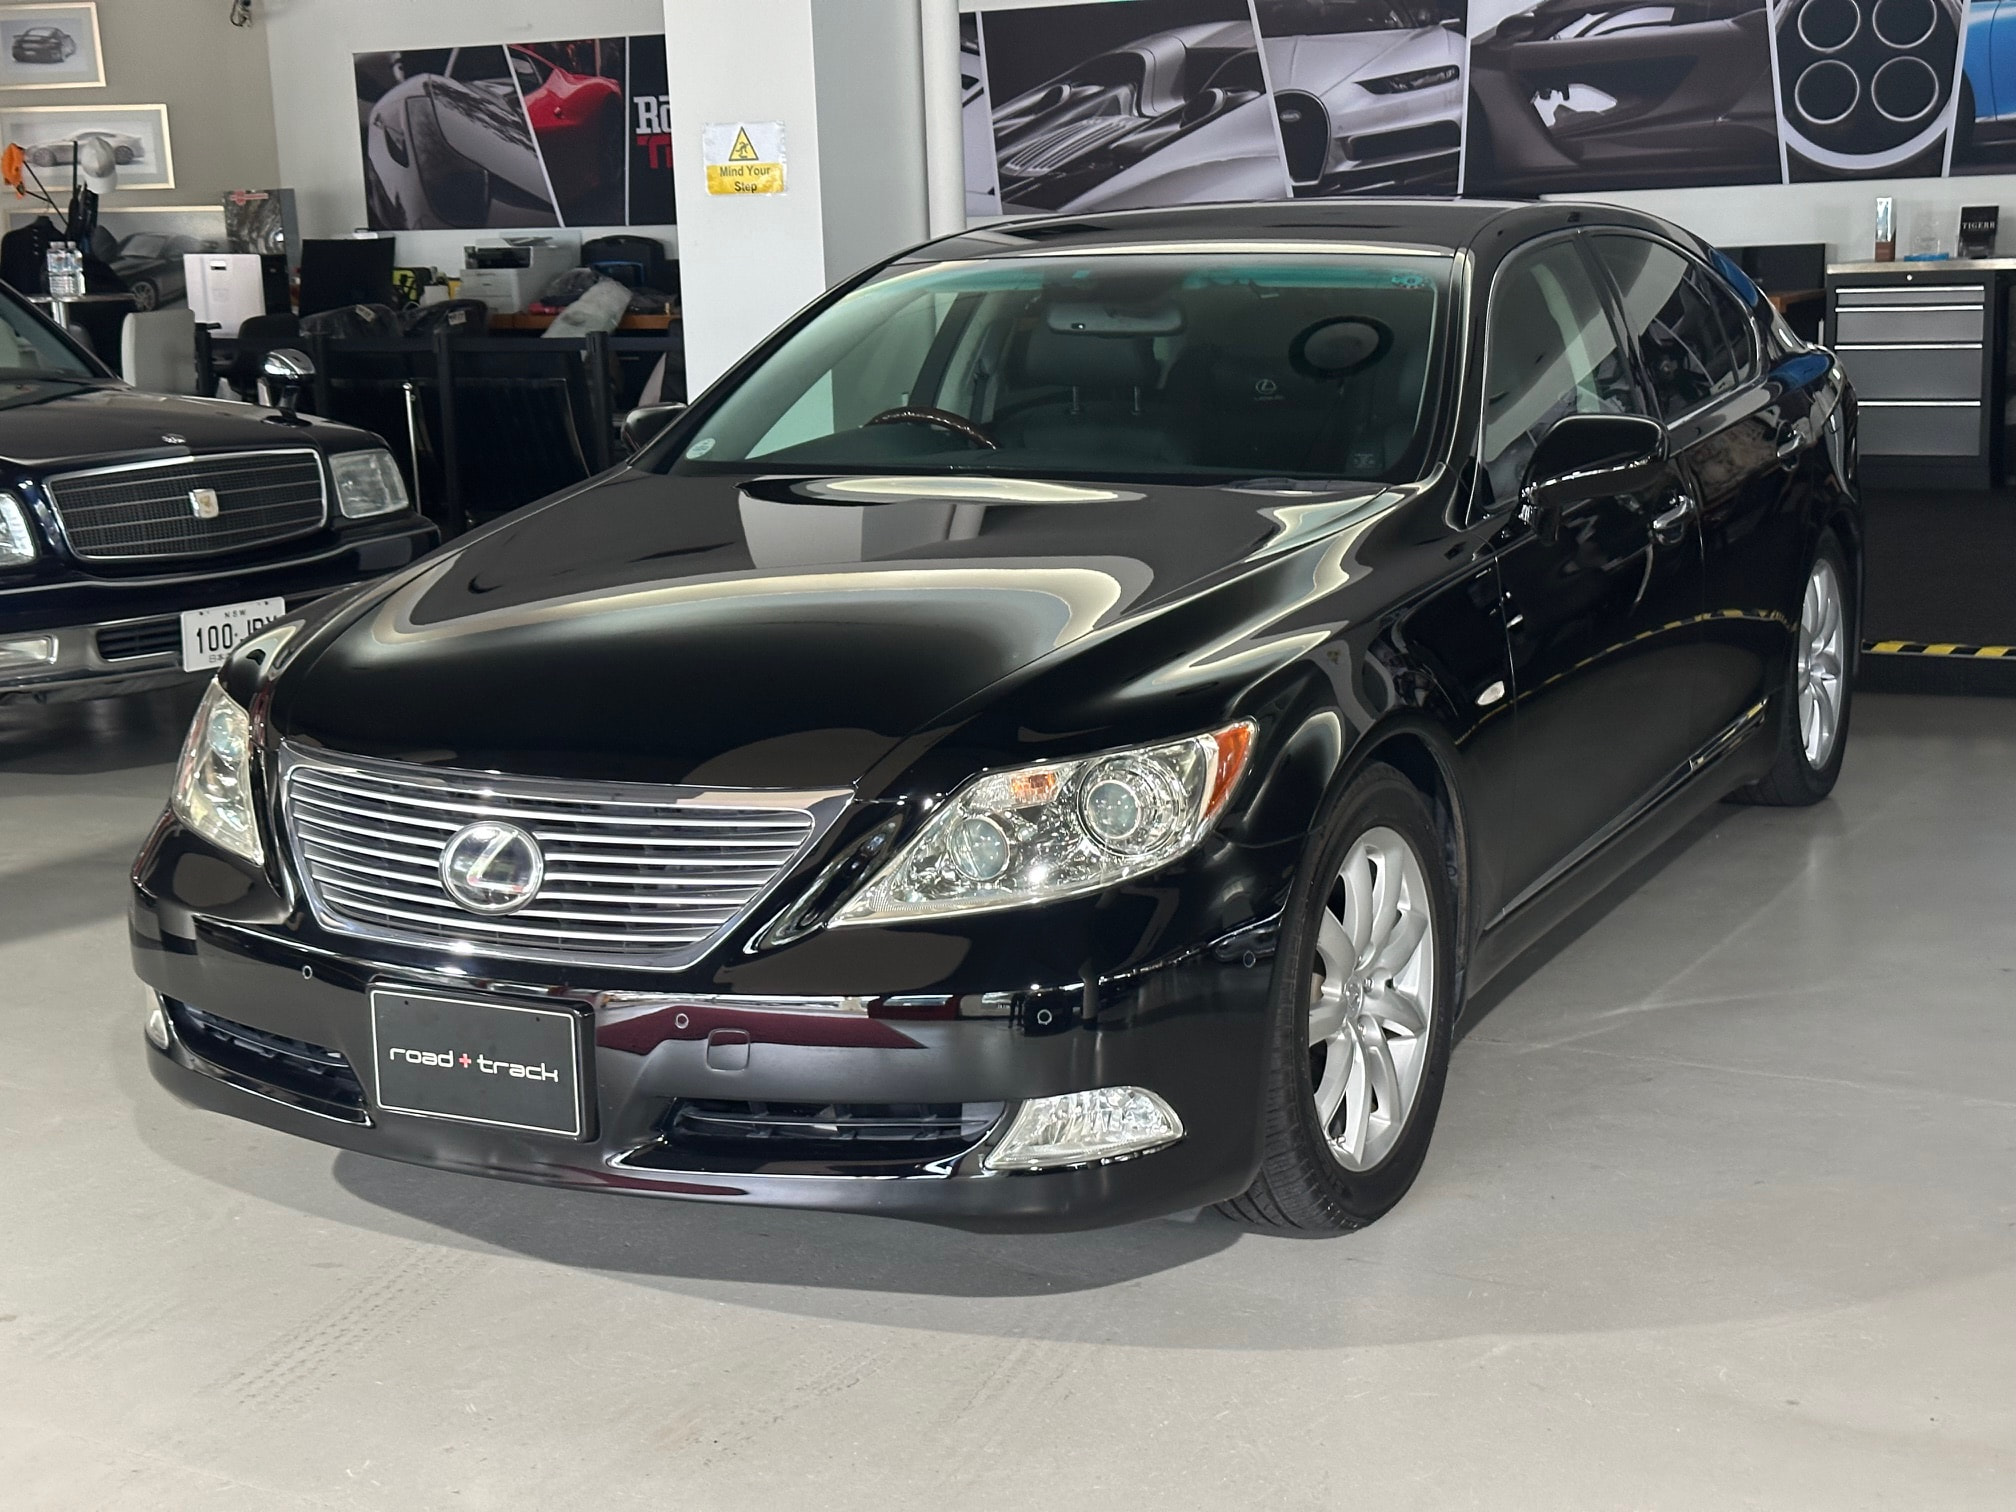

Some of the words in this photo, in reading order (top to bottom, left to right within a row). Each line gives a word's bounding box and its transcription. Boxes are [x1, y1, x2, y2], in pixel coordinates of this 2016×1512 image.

[637, 134, 673, 169] T
[720, 165, 744, 177] Mind
[746, 165, 771, 176] Your
[734, 181, 758, 193] Step
[225, 610, 246, 618] NSW
[390, 1048, 454, 1068] road
[477, 1054, 559, 1082] track
